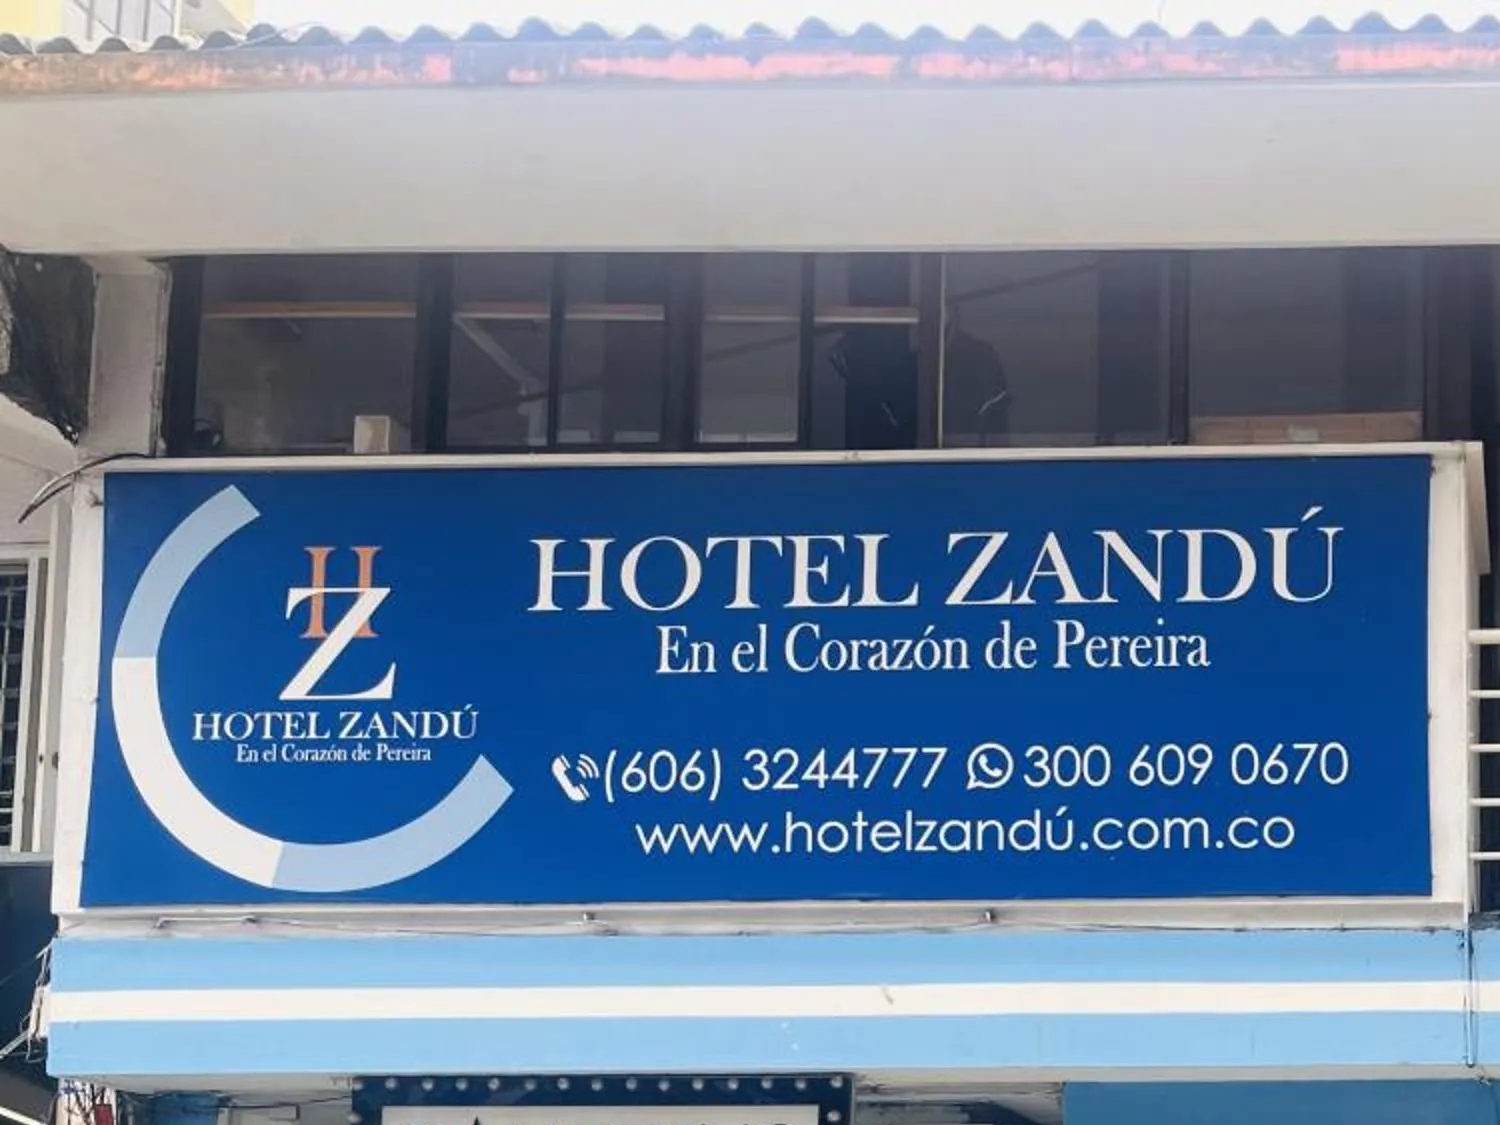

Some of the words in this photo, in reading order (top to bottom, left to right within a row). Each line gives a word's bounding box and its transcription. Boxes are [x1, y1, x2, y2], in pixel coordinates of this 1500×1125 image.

[527, 533, 919, 611] HOTEL
[945, 506, 1343, 605] ZANDÚ
[656, 625, 716, 673] En
[731, 623, 768, 673] el
[785, 622, 969, 672] Corazón
[985, 620, 1037, 669] de
[1054, 618, 1211, 668] Pereira
[192, 711, 331, 742] HOTEL
[339, 704, 479, 740] ZANDÚ
[236, 743, 259, 763] En
[263, 742, 277, 762] el
[281, 743, 348, 762] Corazón
[352, 744, 372, 761] de
[377, 743, 431, 761] Pereira
[605, 749, 722, 803] (606)
[742, 747, 947, 791] 3244777
[1023, 744, 1111, 788] 300
[1129, 743, 1213, 787] 609
[1231, 742, 1349, 785] 0670
[635, 806, 1295, 854] www.hotelzandú.com.co
